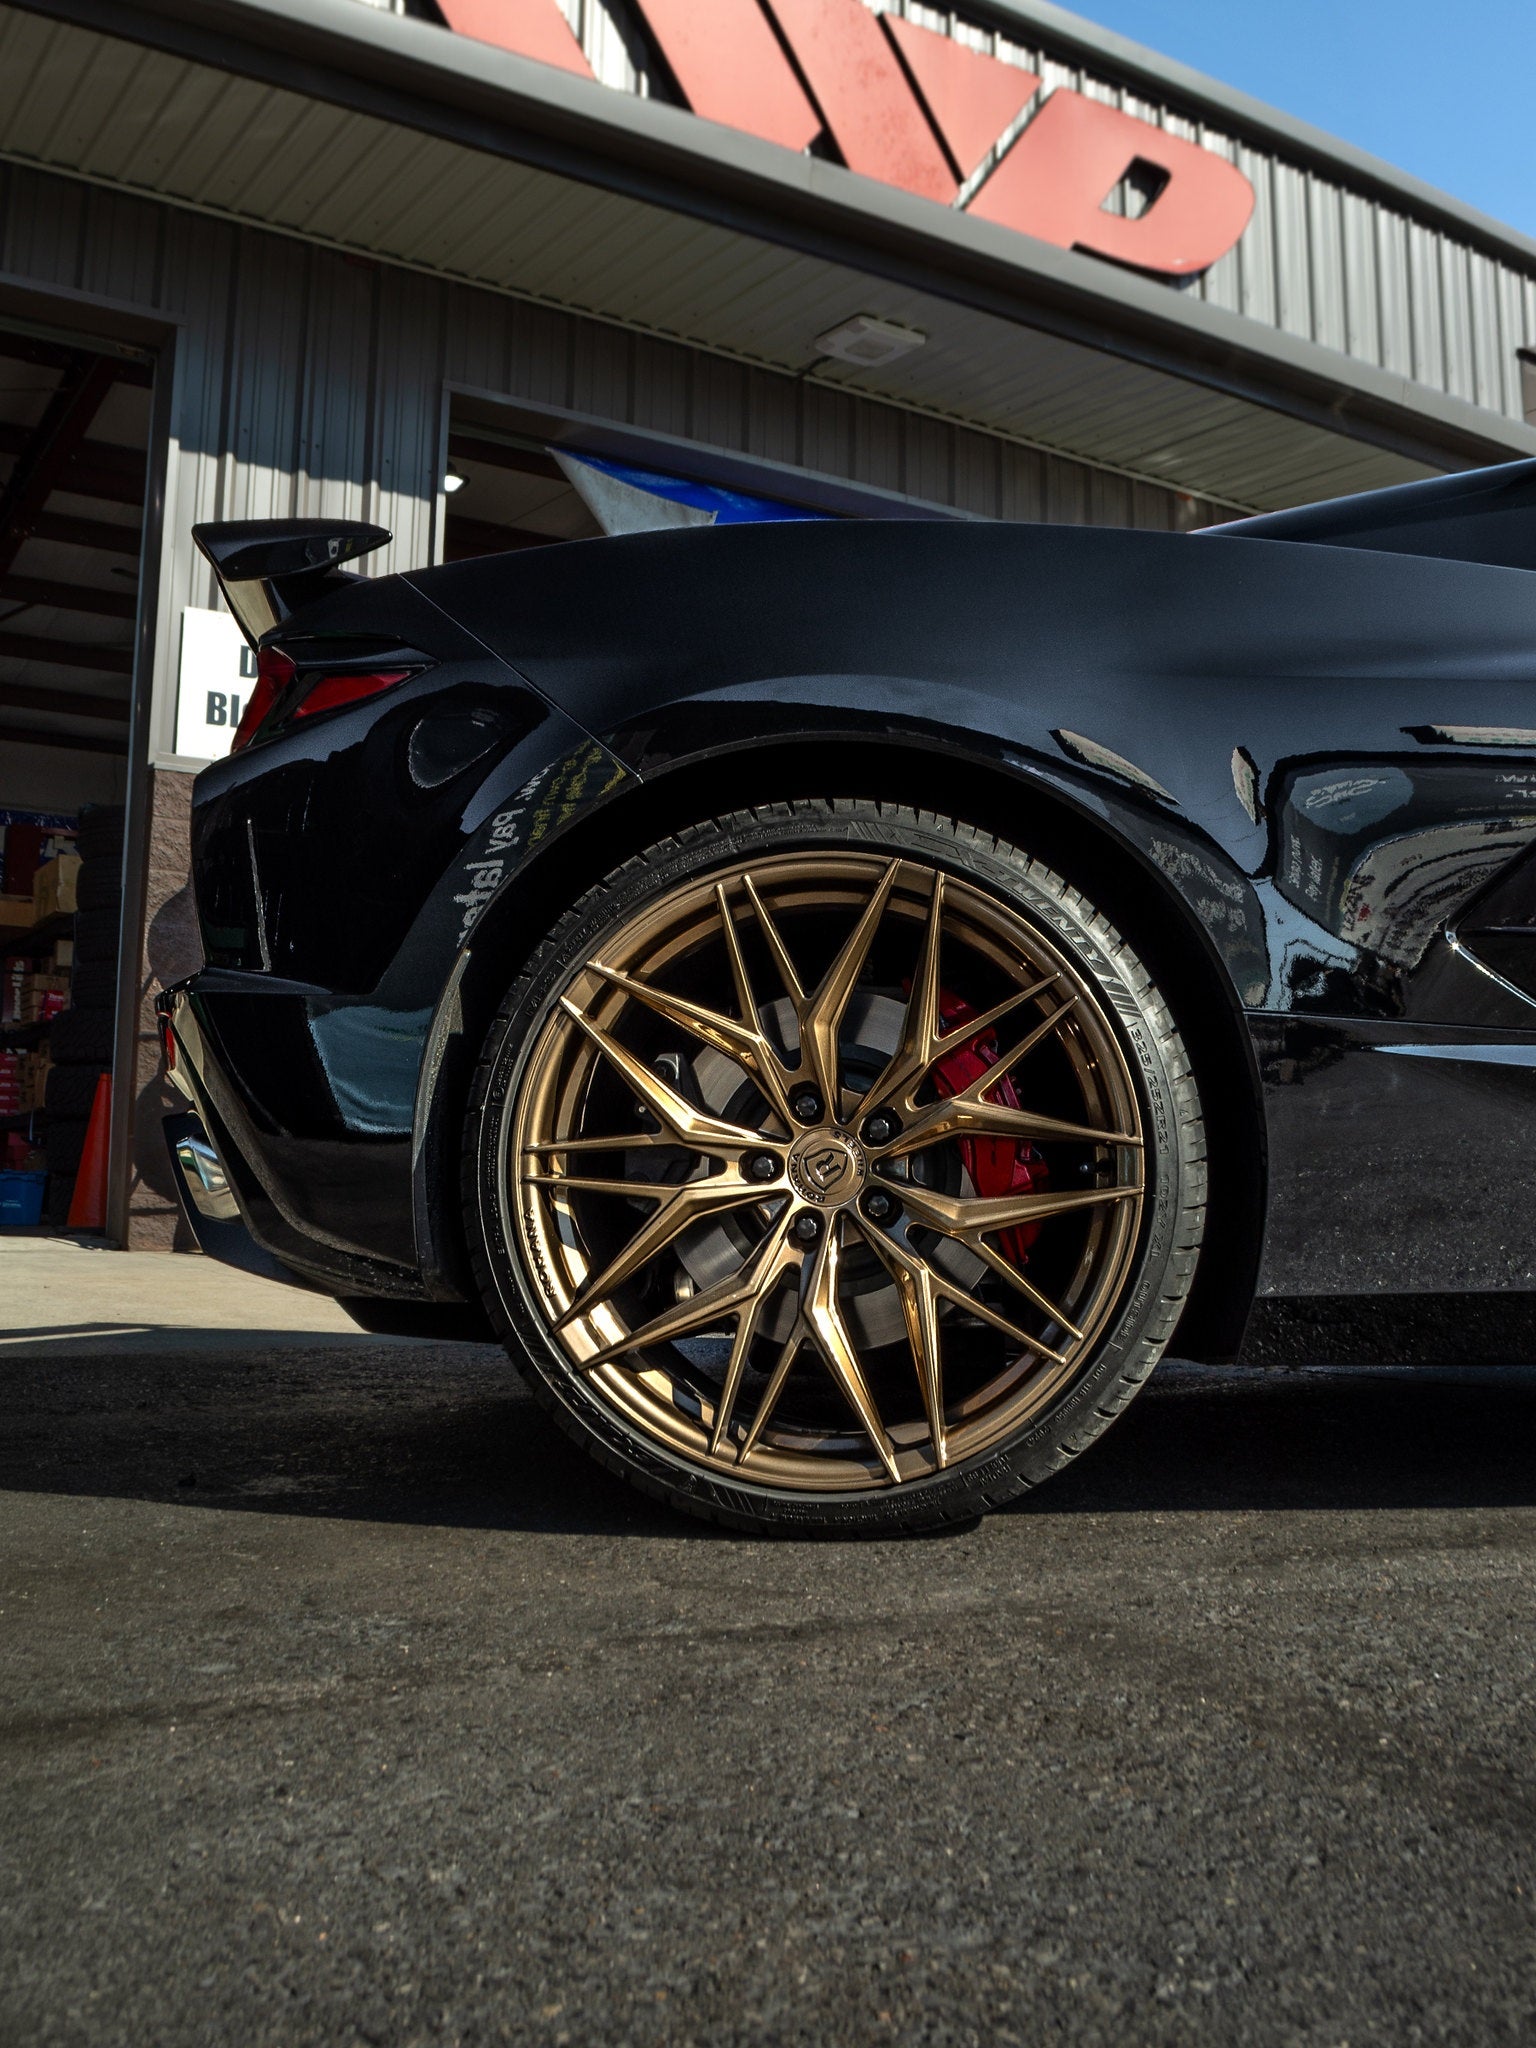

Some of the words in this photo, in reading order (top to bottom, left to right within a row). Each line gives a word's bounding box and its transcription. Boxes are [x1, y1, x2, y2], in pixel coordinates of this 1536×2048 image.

[790, 1152, 826, 1203] ROHANA
[815, 1152, 841, 1182] R
[832, 1131, 864, 1177] WHEELS
[523, 1208, 557, 1298] ROHANA
